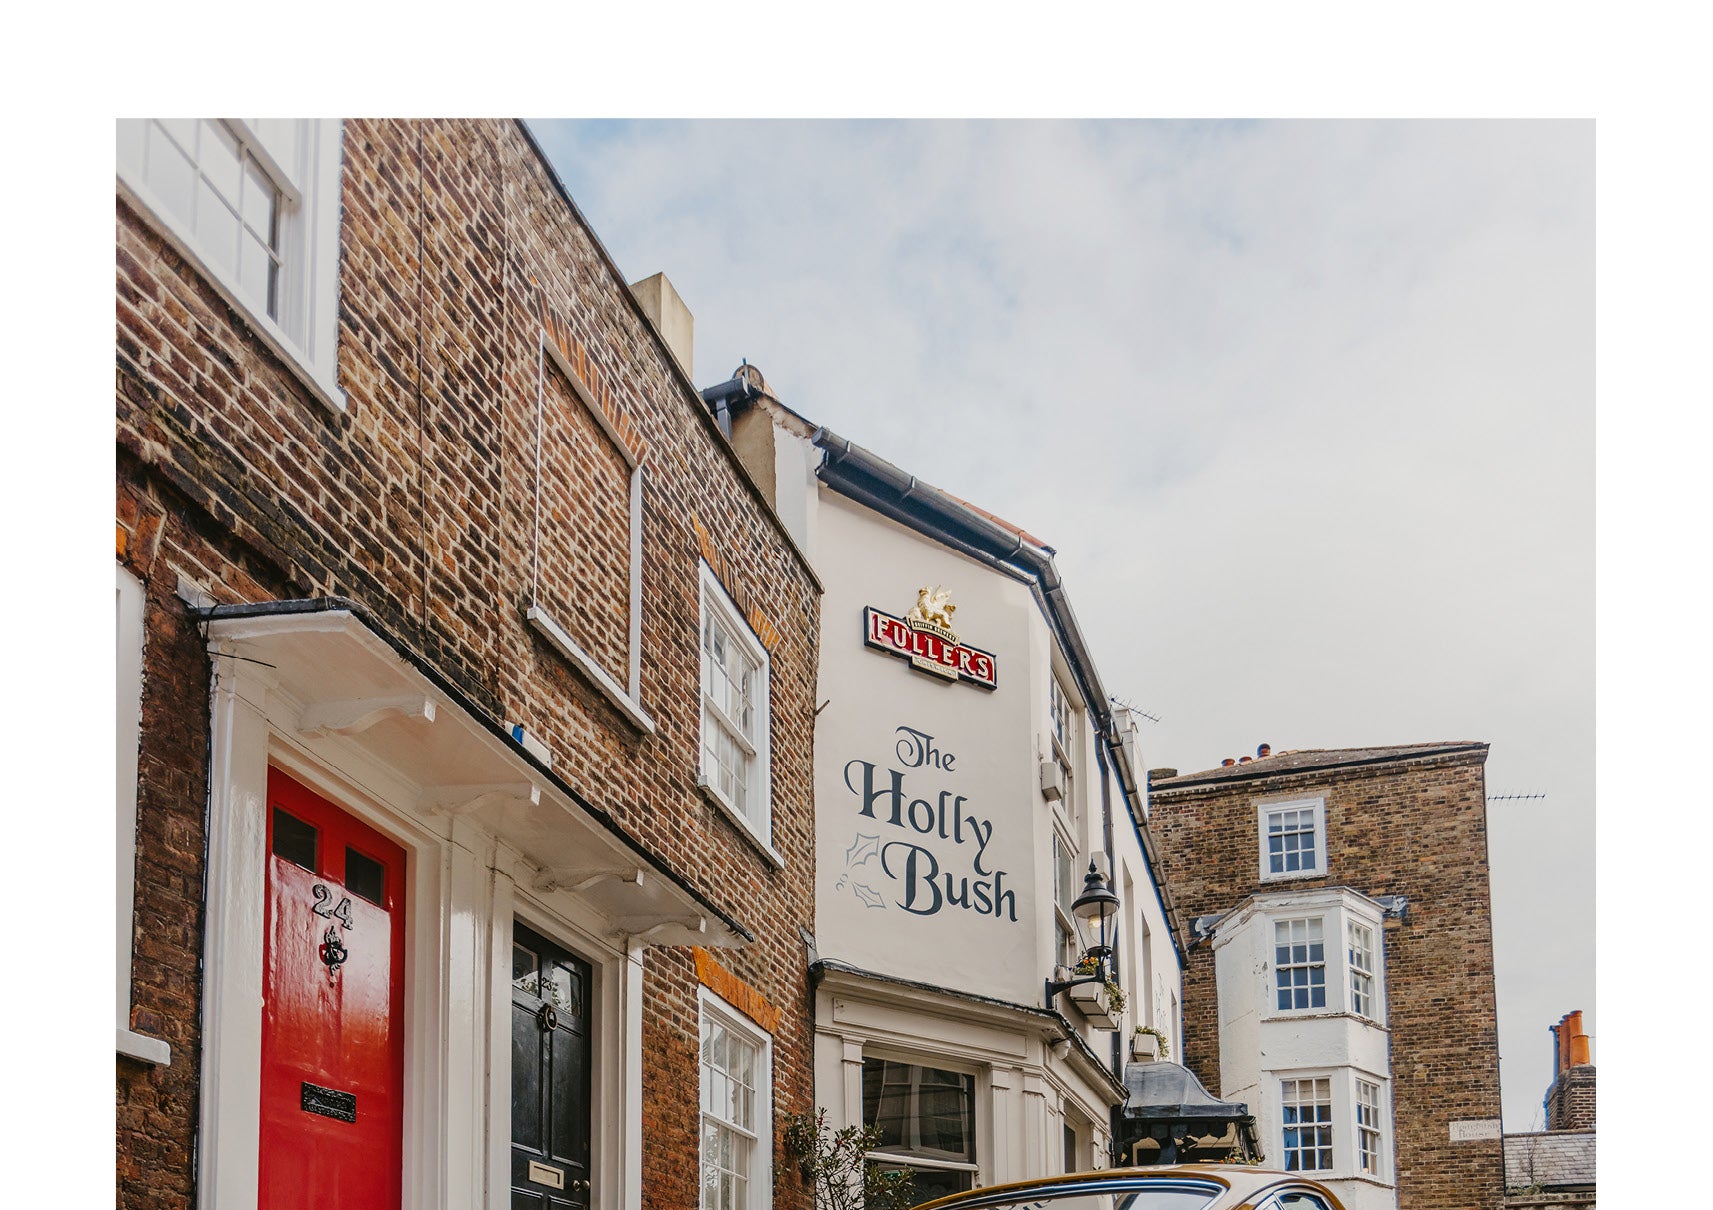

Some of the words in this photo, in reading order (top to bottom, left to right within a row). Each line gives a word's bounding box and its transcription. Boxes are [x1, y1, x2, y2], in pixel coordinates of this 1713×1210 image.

[895, 725, 956, 772] The
[843, 759, 993, 876] Holly
[312, 883, 354, 931] 24
[880, 840, 1019, 923] Bush
